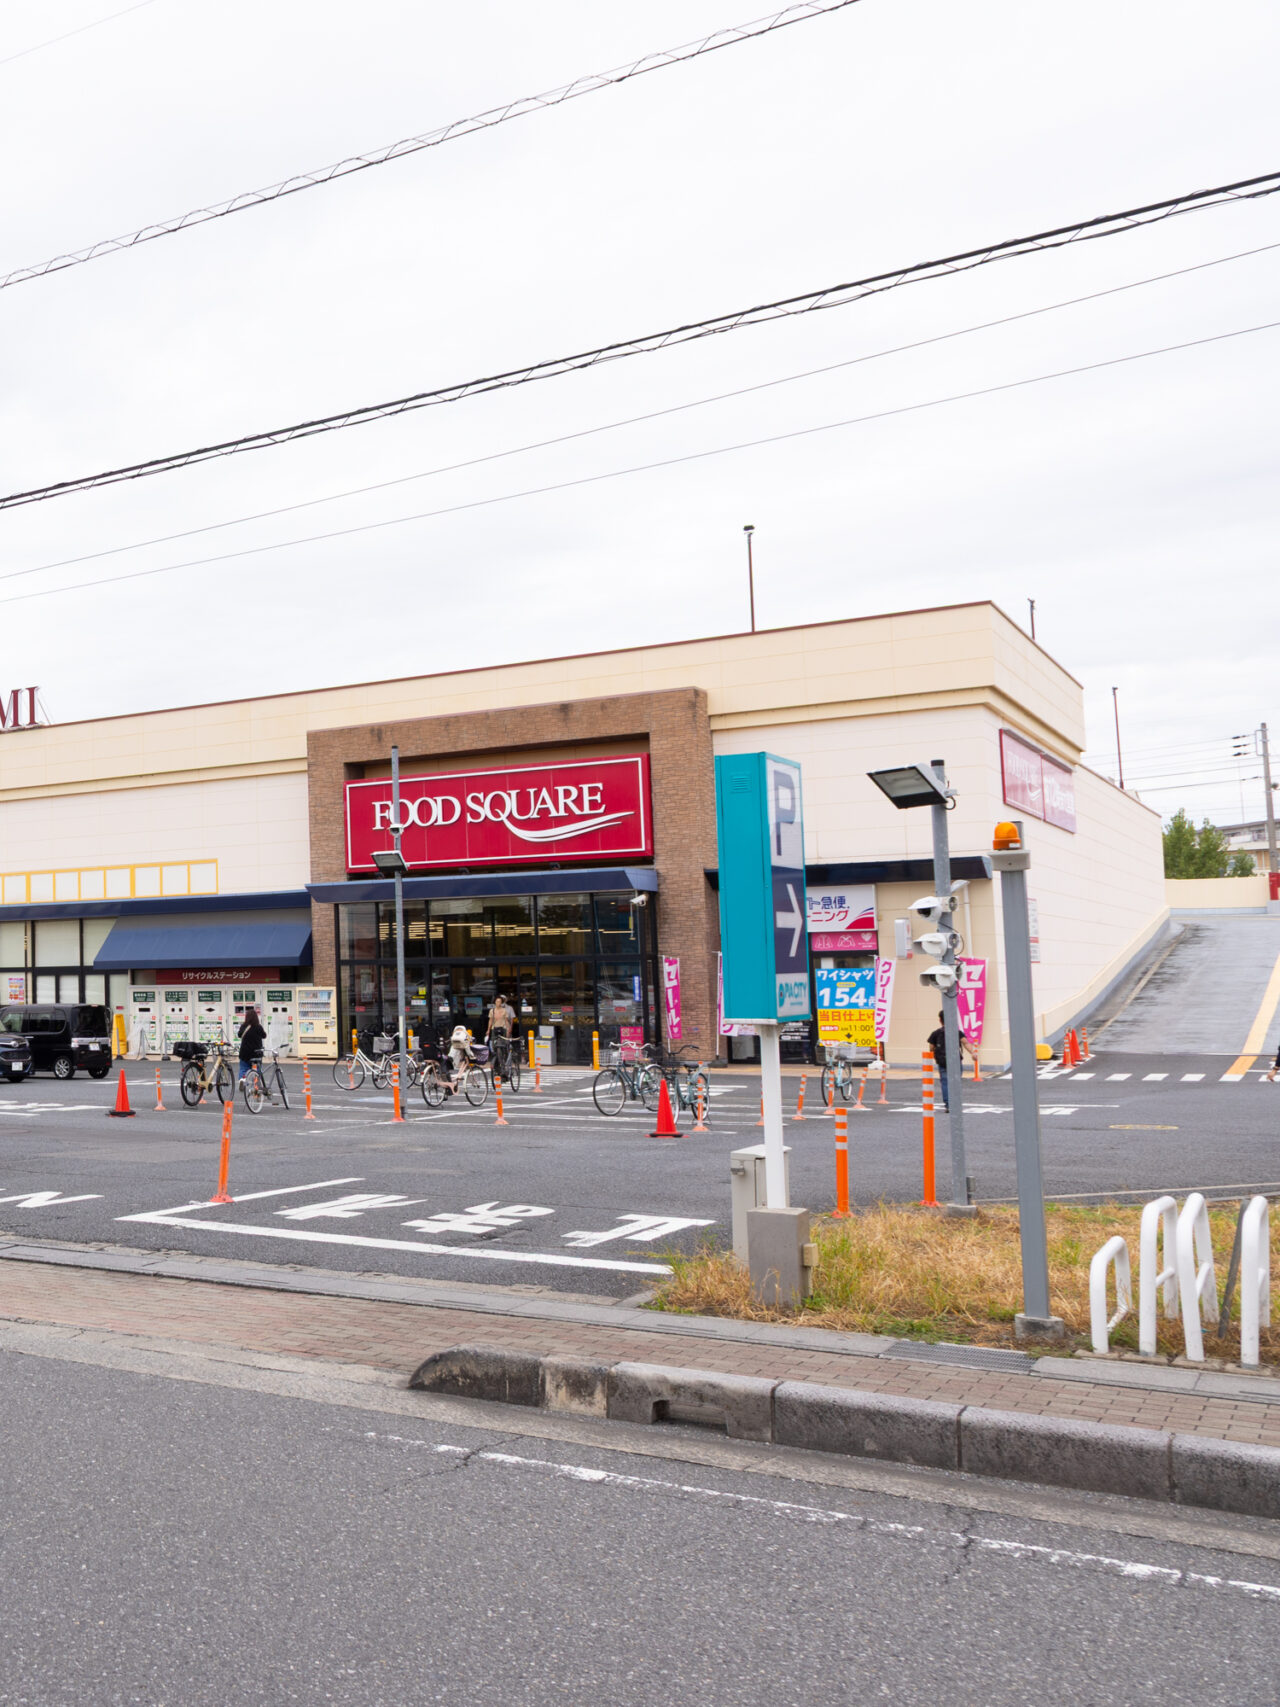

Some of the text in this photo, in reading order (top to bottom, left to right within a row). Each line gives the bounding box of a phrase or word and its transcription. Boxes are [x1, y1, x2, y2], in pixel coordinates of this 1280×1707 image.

[372, 783, 608, 831] FOOD SQUARE
[773, 770, 797, 857] P
[807, 910, 849, 922] ニング
[182, 971, 251, 981] リサイクルステーション
[664, 962, 680, 1026] セール
[817, 969, 874, 981] ワイシャツ
[875, 961, 892, 1039] クリーニング
[959, 961, 985, 1030] セール
